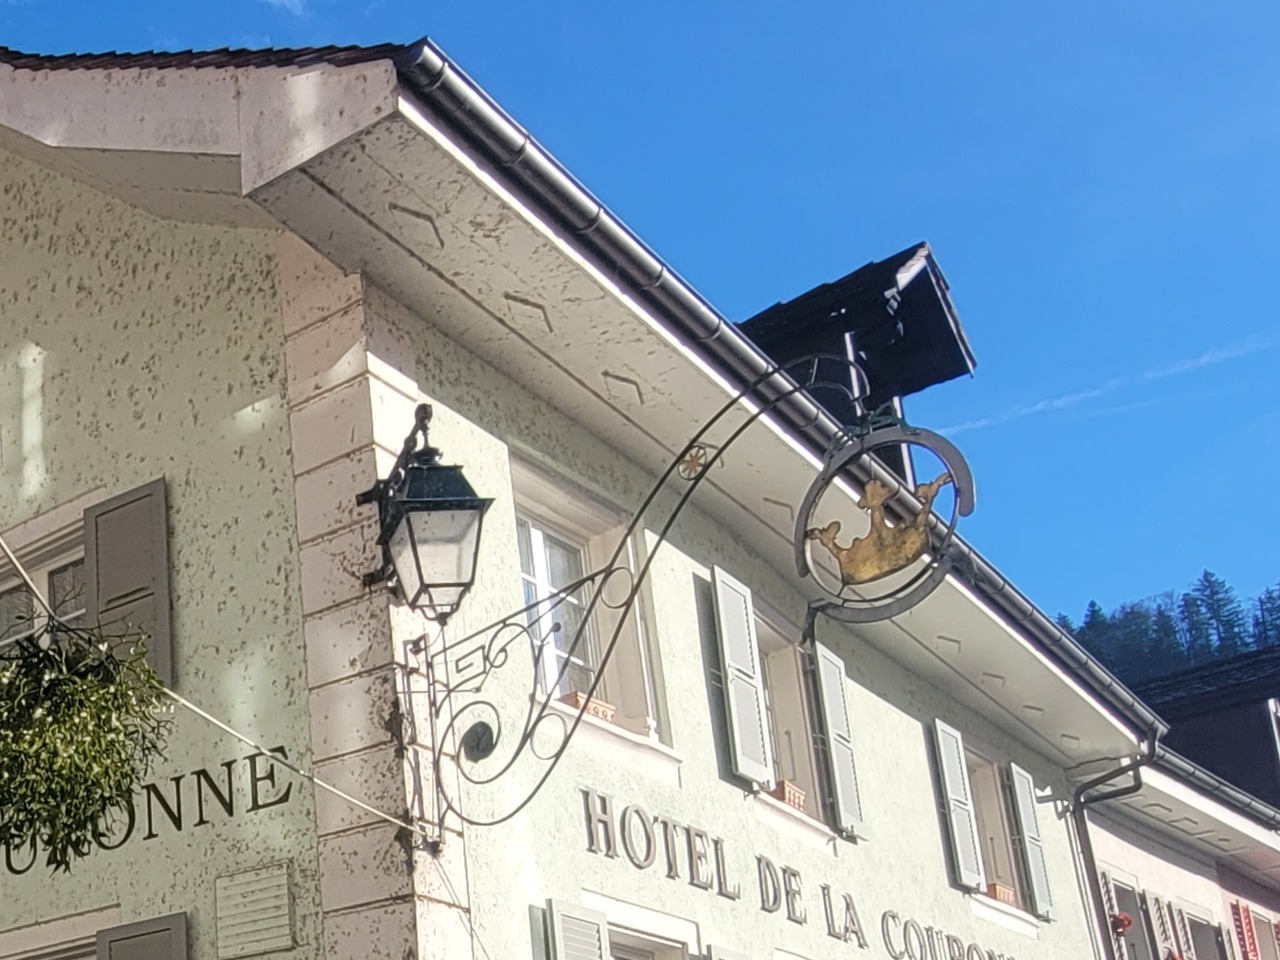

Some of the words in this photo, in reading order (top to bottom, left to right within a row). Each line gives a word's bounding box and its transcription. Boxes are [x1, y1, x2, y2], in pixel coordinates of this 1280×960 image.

[580, 788, 741, 901] HOTEL
[756, 855, 807, 925] DE
[820, 883, 869, 949] LA
